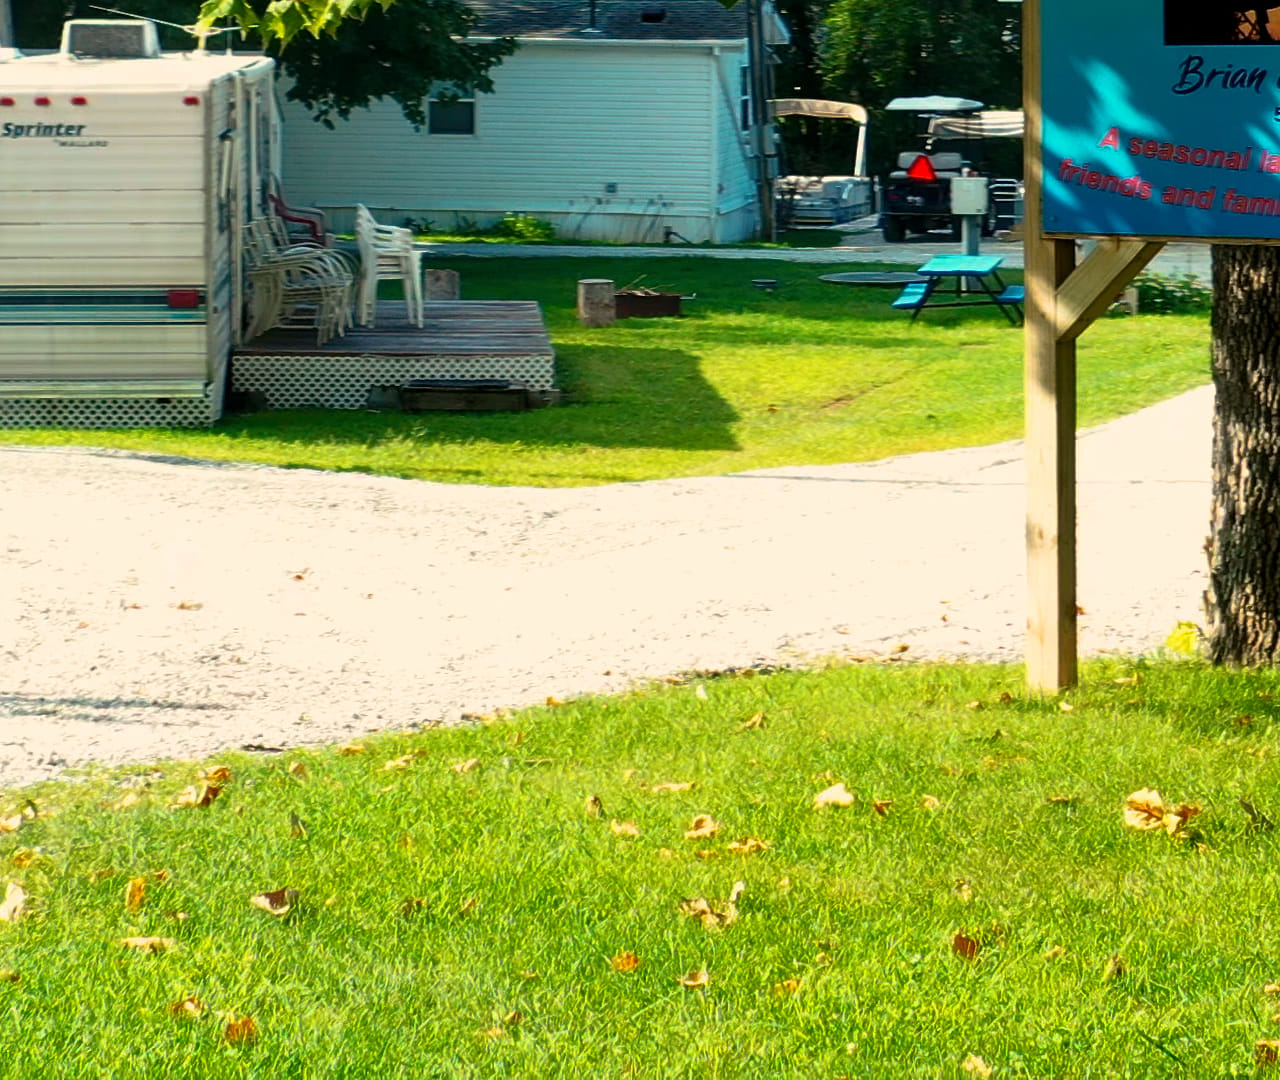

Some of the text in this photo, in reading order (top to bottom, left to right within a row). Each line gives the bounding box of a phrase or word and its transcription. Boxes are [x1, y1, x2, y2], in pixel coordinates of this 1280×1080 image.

[1172, 55, 1267, 95] Brian
[1, 122, 87, 139] Sprinter
[1098, 127, 1120, 151] A
[1128, 136, 1252, 170] seasonal
[1059, 158, 1153, 200] friends
[1161, 184, 1216, 210] and
